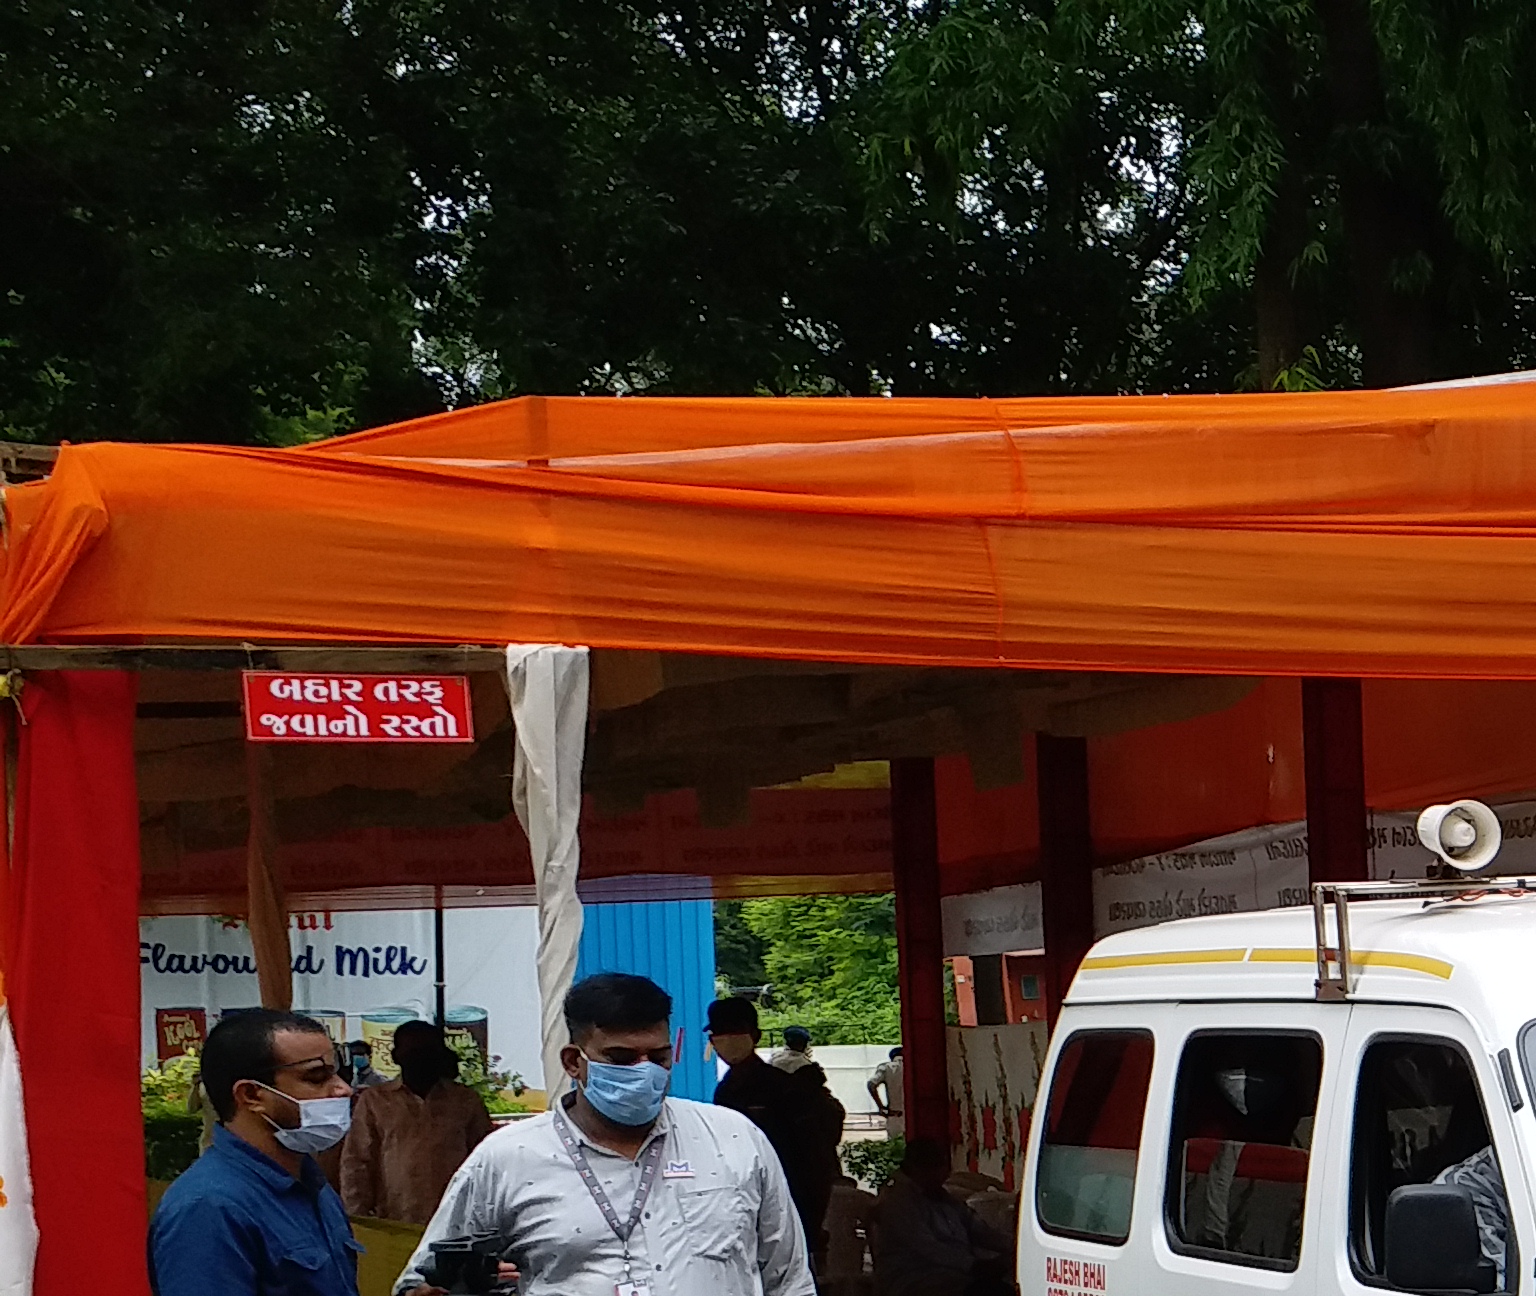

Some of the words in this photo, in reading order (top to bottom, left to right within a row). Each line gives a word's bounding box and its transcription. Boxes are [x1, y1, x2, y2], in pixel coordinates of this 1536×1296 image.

[269, 677, 364, 704] બહાર
[373, 679, 445, 705] તરફ
[259, 704, 371, 737] જવાનો
[379, 705, 458, 737] રસ્તો
[139, 941, 325, 975] Flavoud
[335, 944, 428, 978] Milk
[1046, 1256, 1081, 1287] RAJESH
[1083, 1262, 1106, 1291] BHAI
